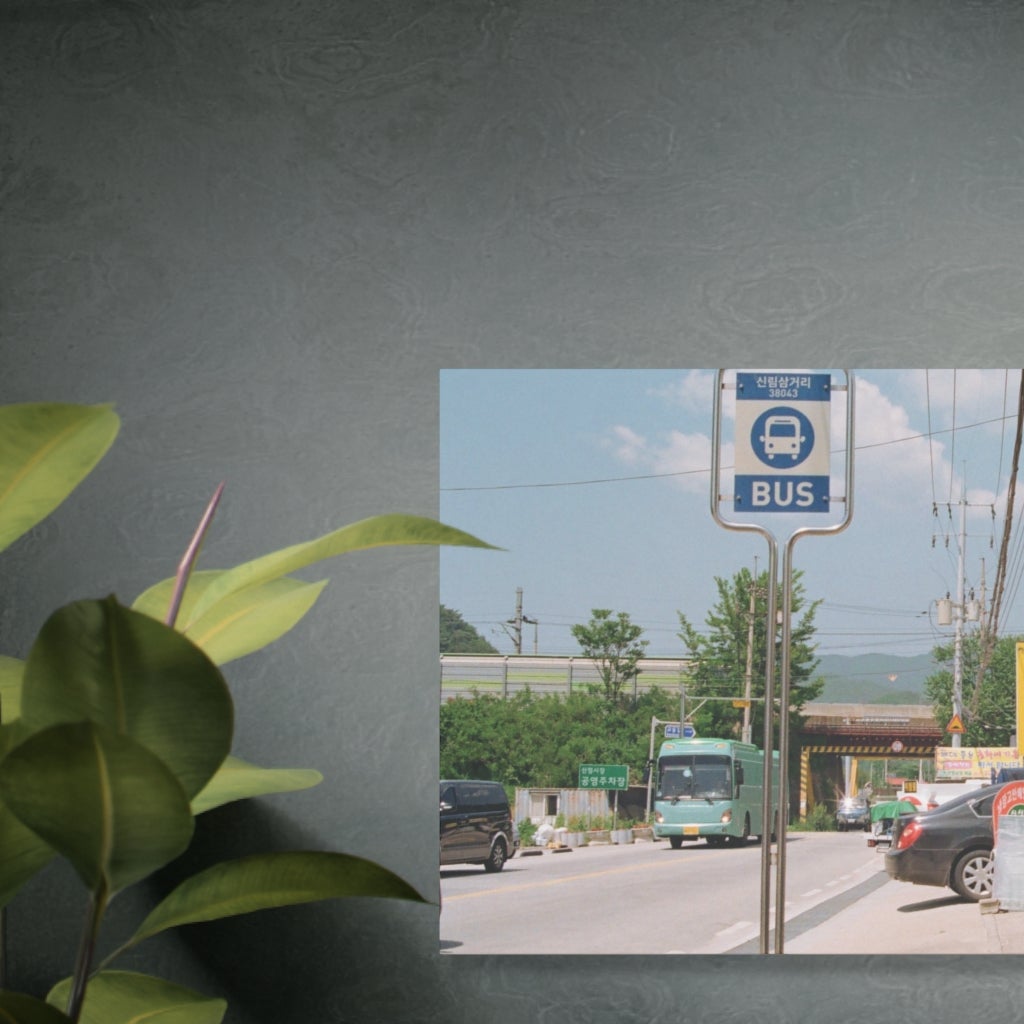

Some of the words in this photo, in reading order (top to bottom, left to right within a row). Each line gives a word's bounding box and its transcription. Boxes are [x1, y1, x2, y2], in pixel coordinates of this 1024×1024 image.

[756, 376, 811, 389] 신림삼거리
[768, 389, 799, 398] 38043
[751, 481, 815, 507] BUS
[581, 776, 626, 787] 공영주차장
